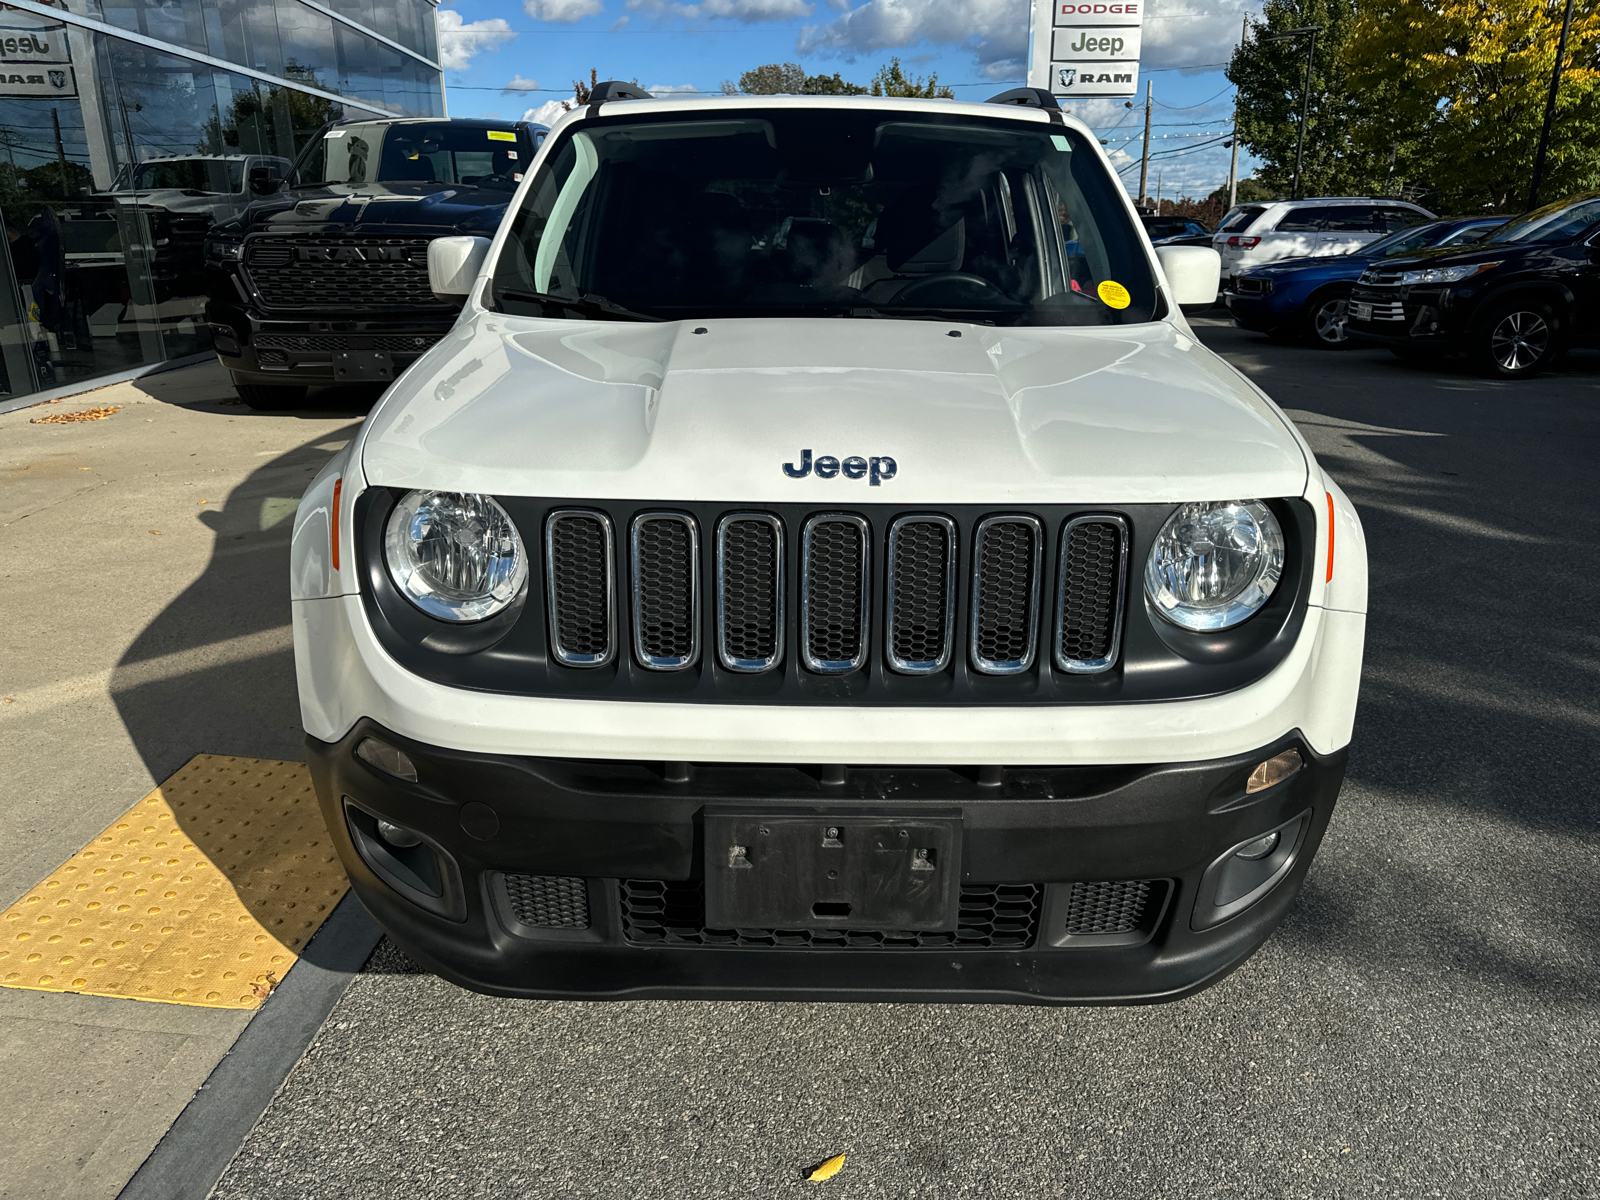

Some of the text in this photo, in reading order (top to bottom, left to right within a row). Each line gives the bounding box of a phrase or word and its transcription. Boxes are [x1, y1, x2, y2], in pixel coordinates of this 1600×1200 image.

[1062, 4, 1138, 14] DODGE
[1071, 32, 1124, 56] Jeep
[1080, 74, 1132, 83] RAM
[299, 246, 402, 261] RAM
[782, 449, 897, 486] Jeep
